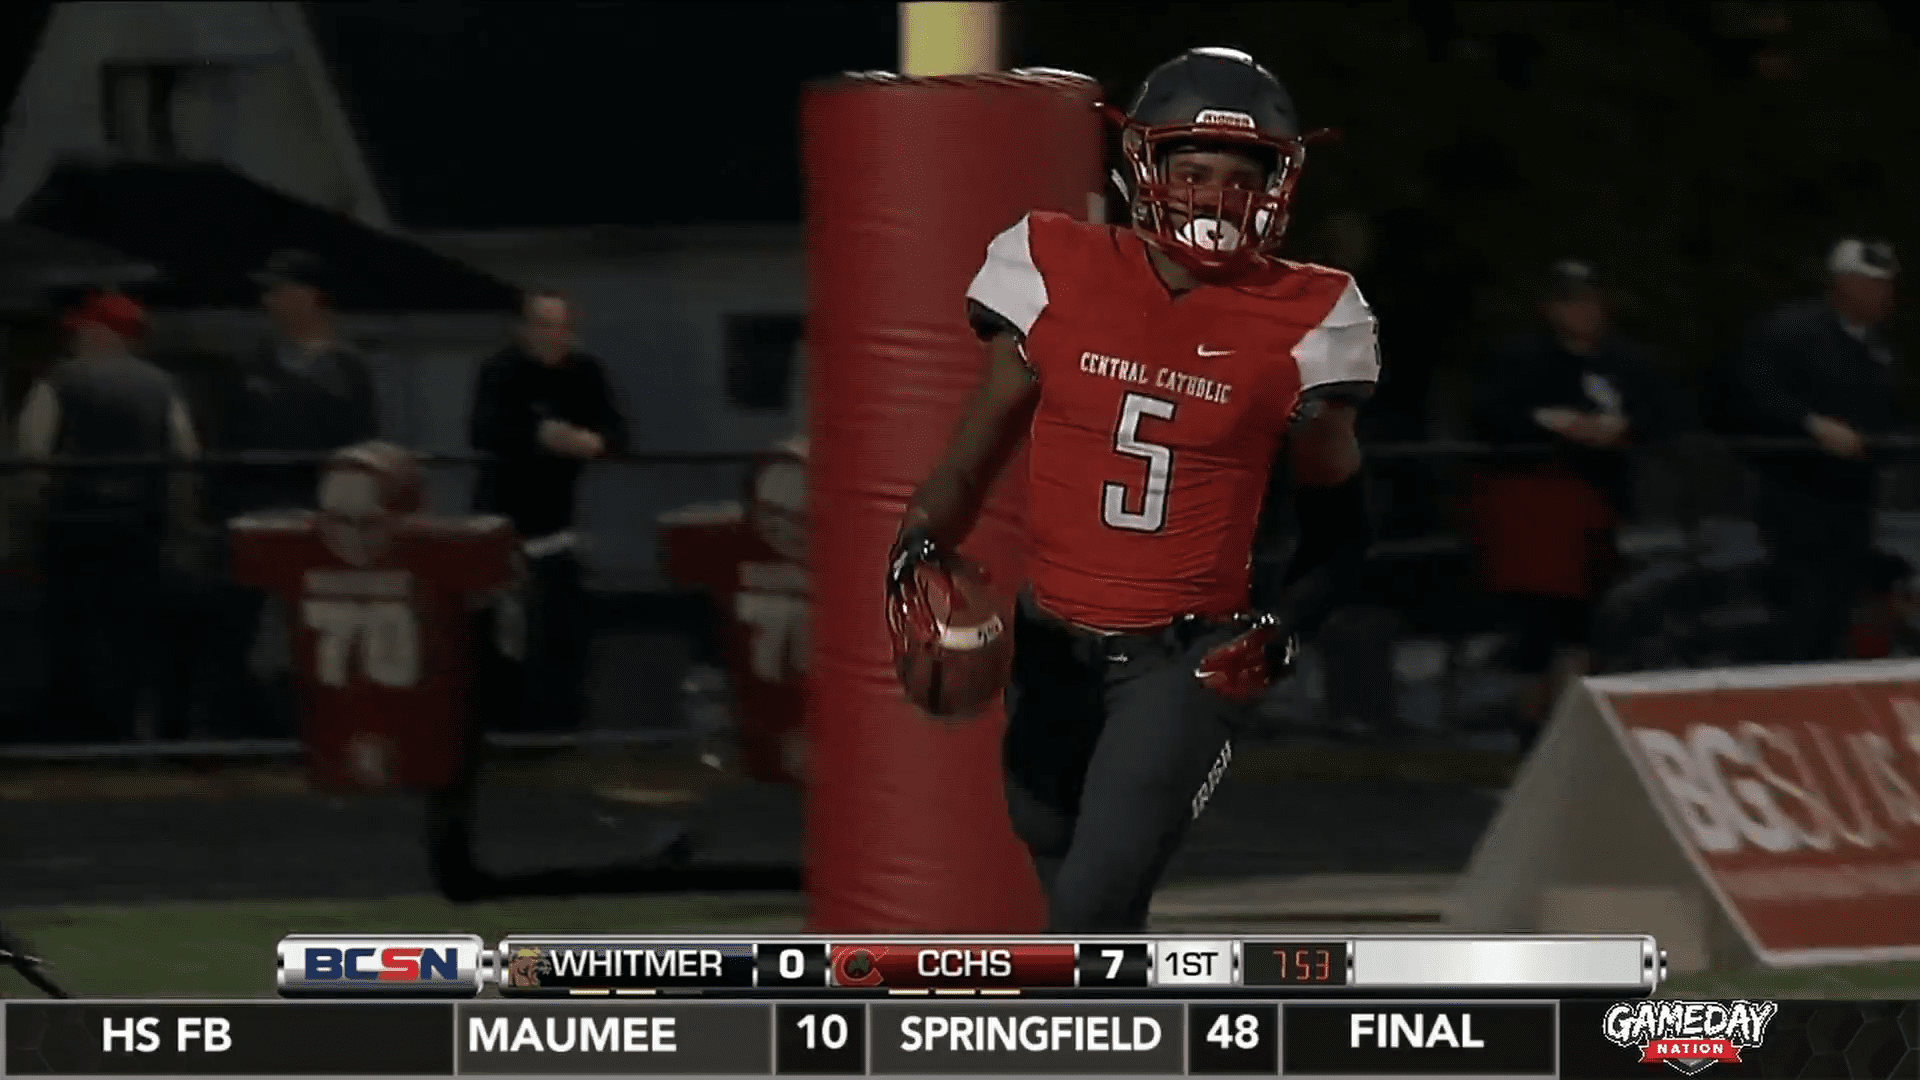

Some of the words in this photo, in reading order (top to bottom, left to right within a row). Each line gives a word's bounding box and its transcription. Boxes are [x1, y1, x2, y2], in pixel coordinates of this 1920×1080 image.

[1079, 351, 1149, 385] CENTRAL
[1155, 367, 1232, 404] CATHOLIC
[1101, 390, 1177, 533] 5
